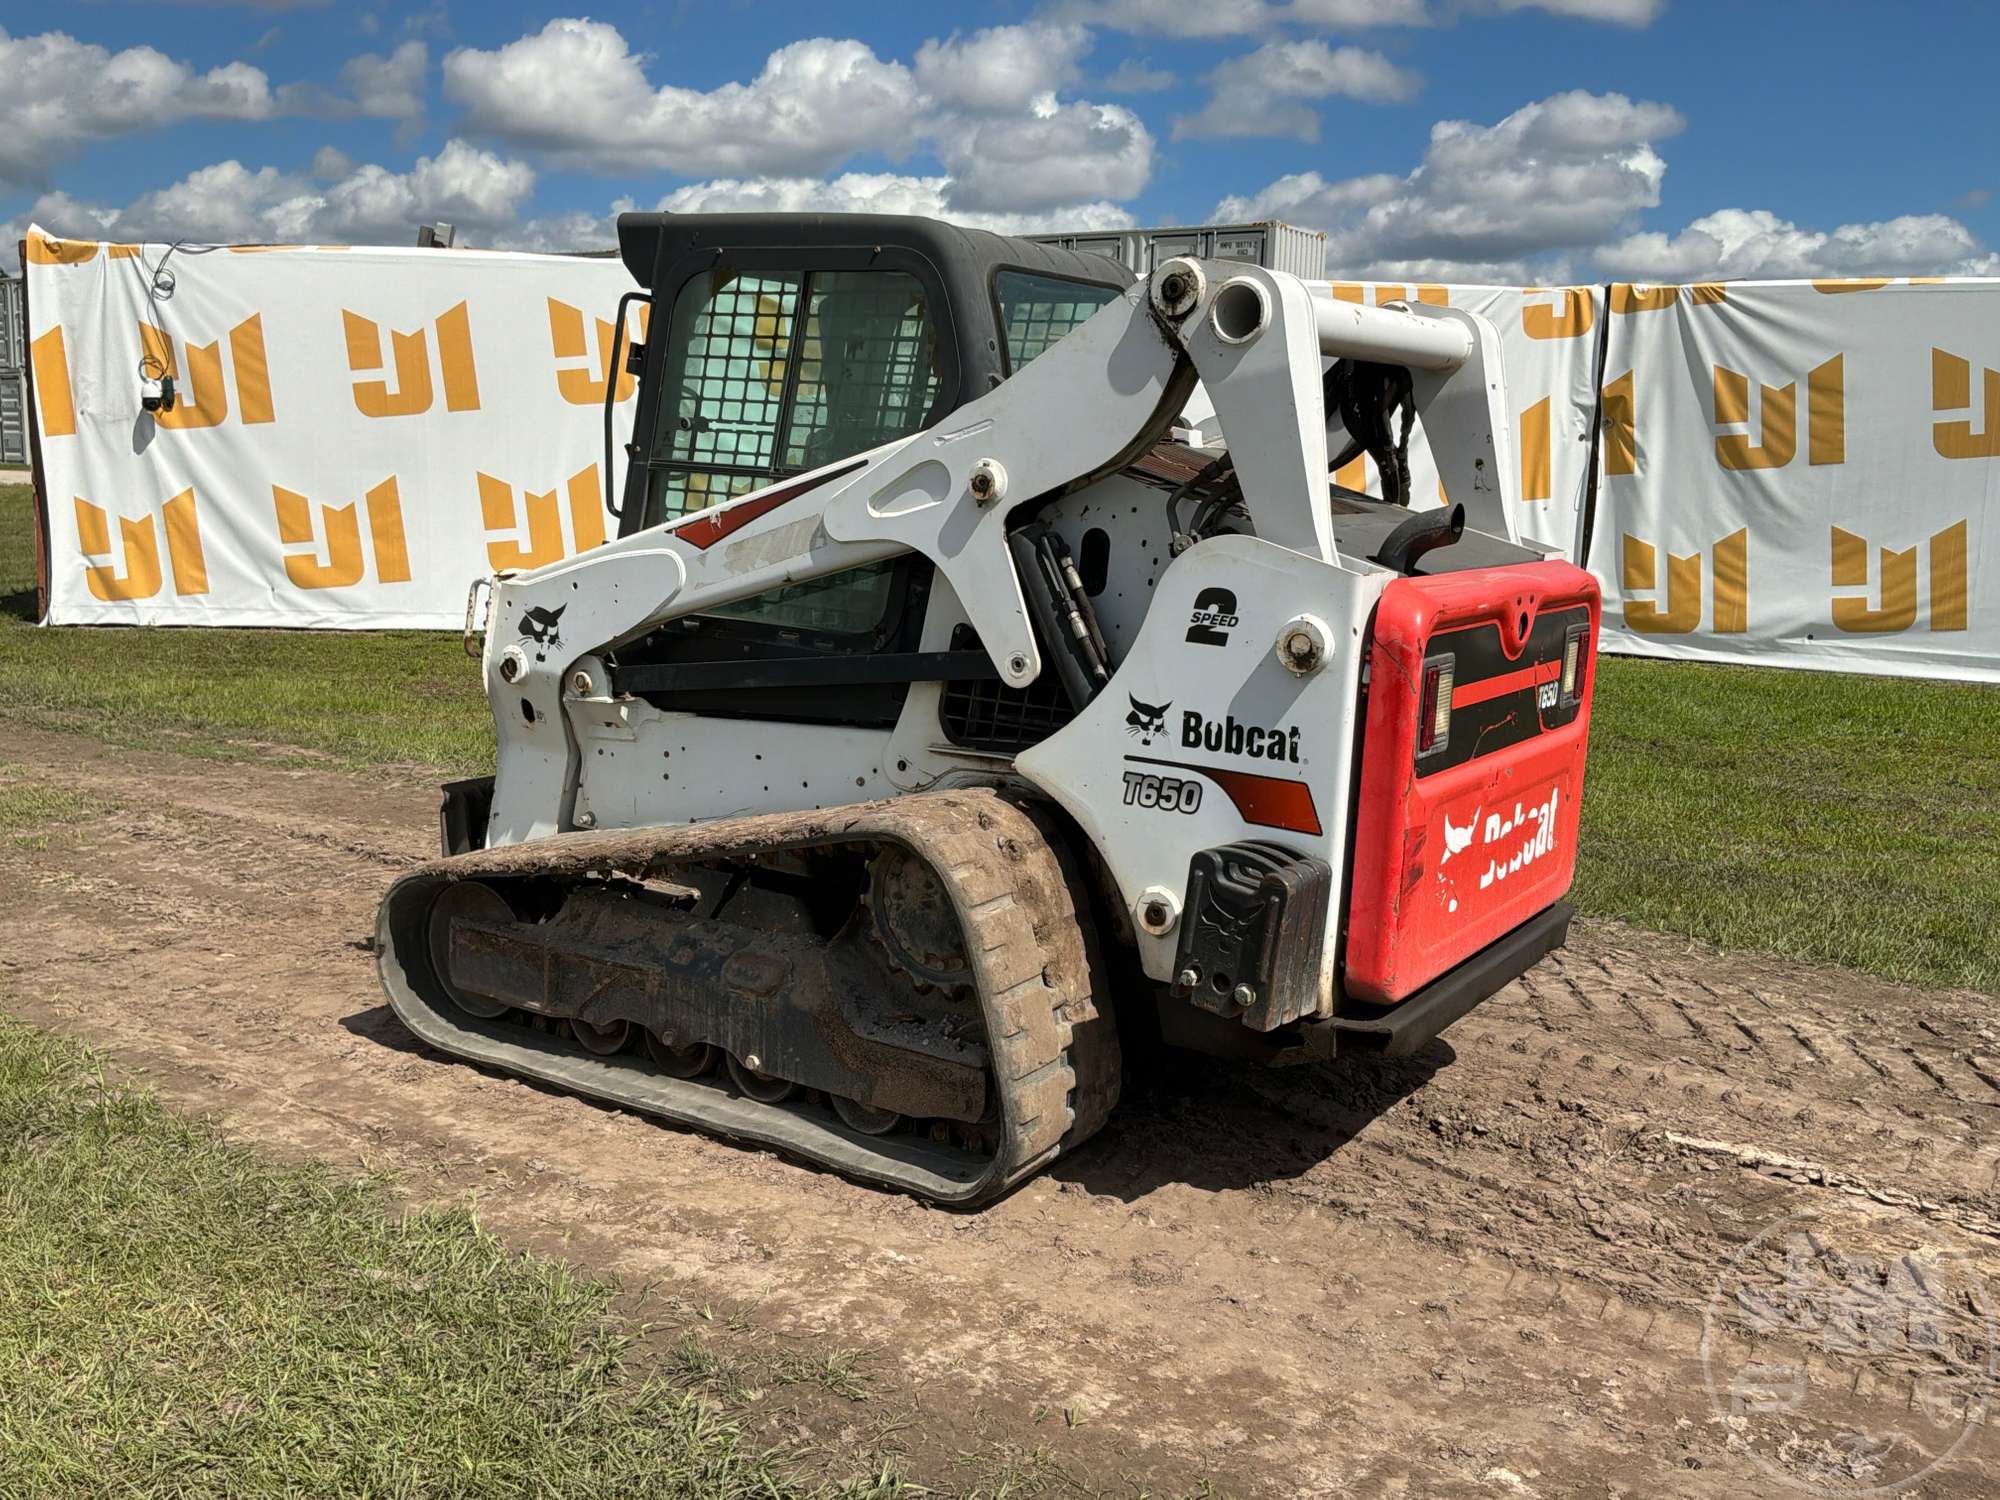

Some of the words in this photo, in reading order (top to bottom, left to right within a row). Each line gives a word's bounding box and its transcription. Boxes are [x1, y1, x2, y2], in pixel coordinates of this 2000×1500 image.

[1185, 587, 1237, 647] 2
[1190, 611, 1239, 628] SPEED
[1538, 681, 1559, 709] T650
[1181, 710, 1300, 763] Bobcat
[1123, 771, 1203, 814] T650
